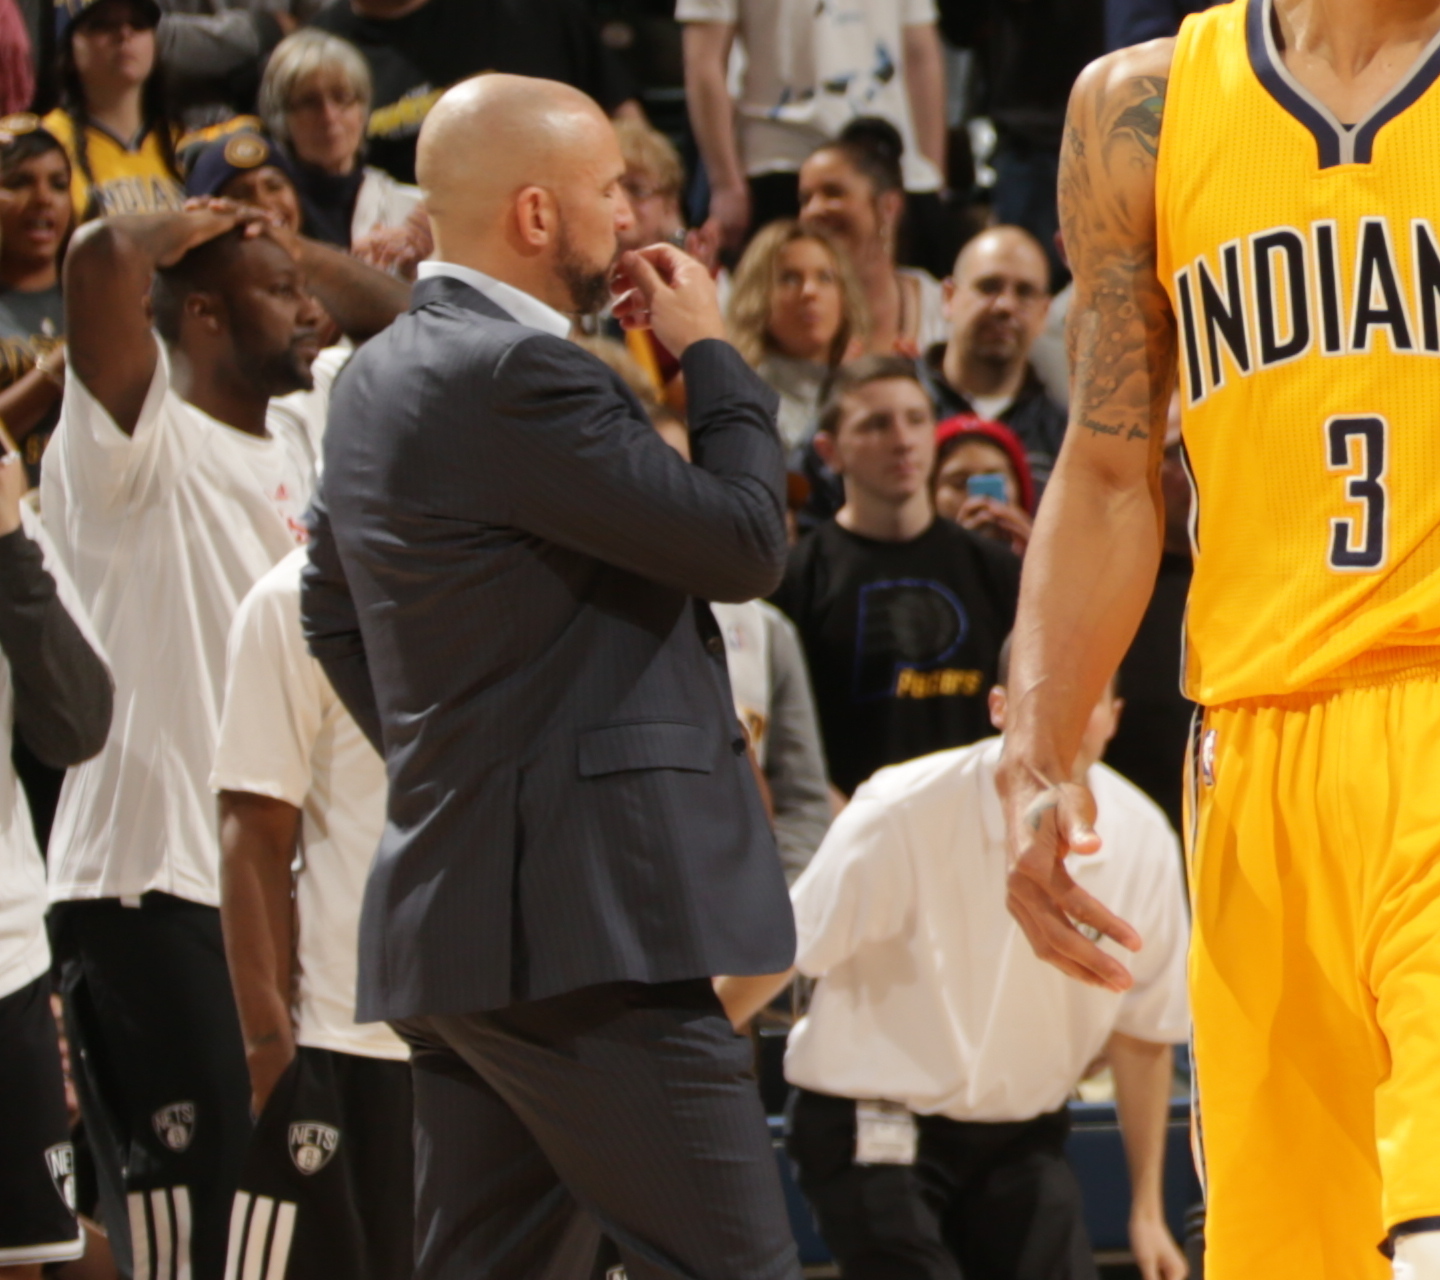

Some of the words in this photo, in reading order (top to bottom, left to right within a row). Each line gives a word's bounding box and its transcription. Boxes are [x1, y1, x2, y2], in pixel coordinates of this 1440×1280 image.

[1324, 413, 1390, 573] 3
[153, 1105, 193, 1131] NETS
[290, 1125, 338, 1151] NETS
